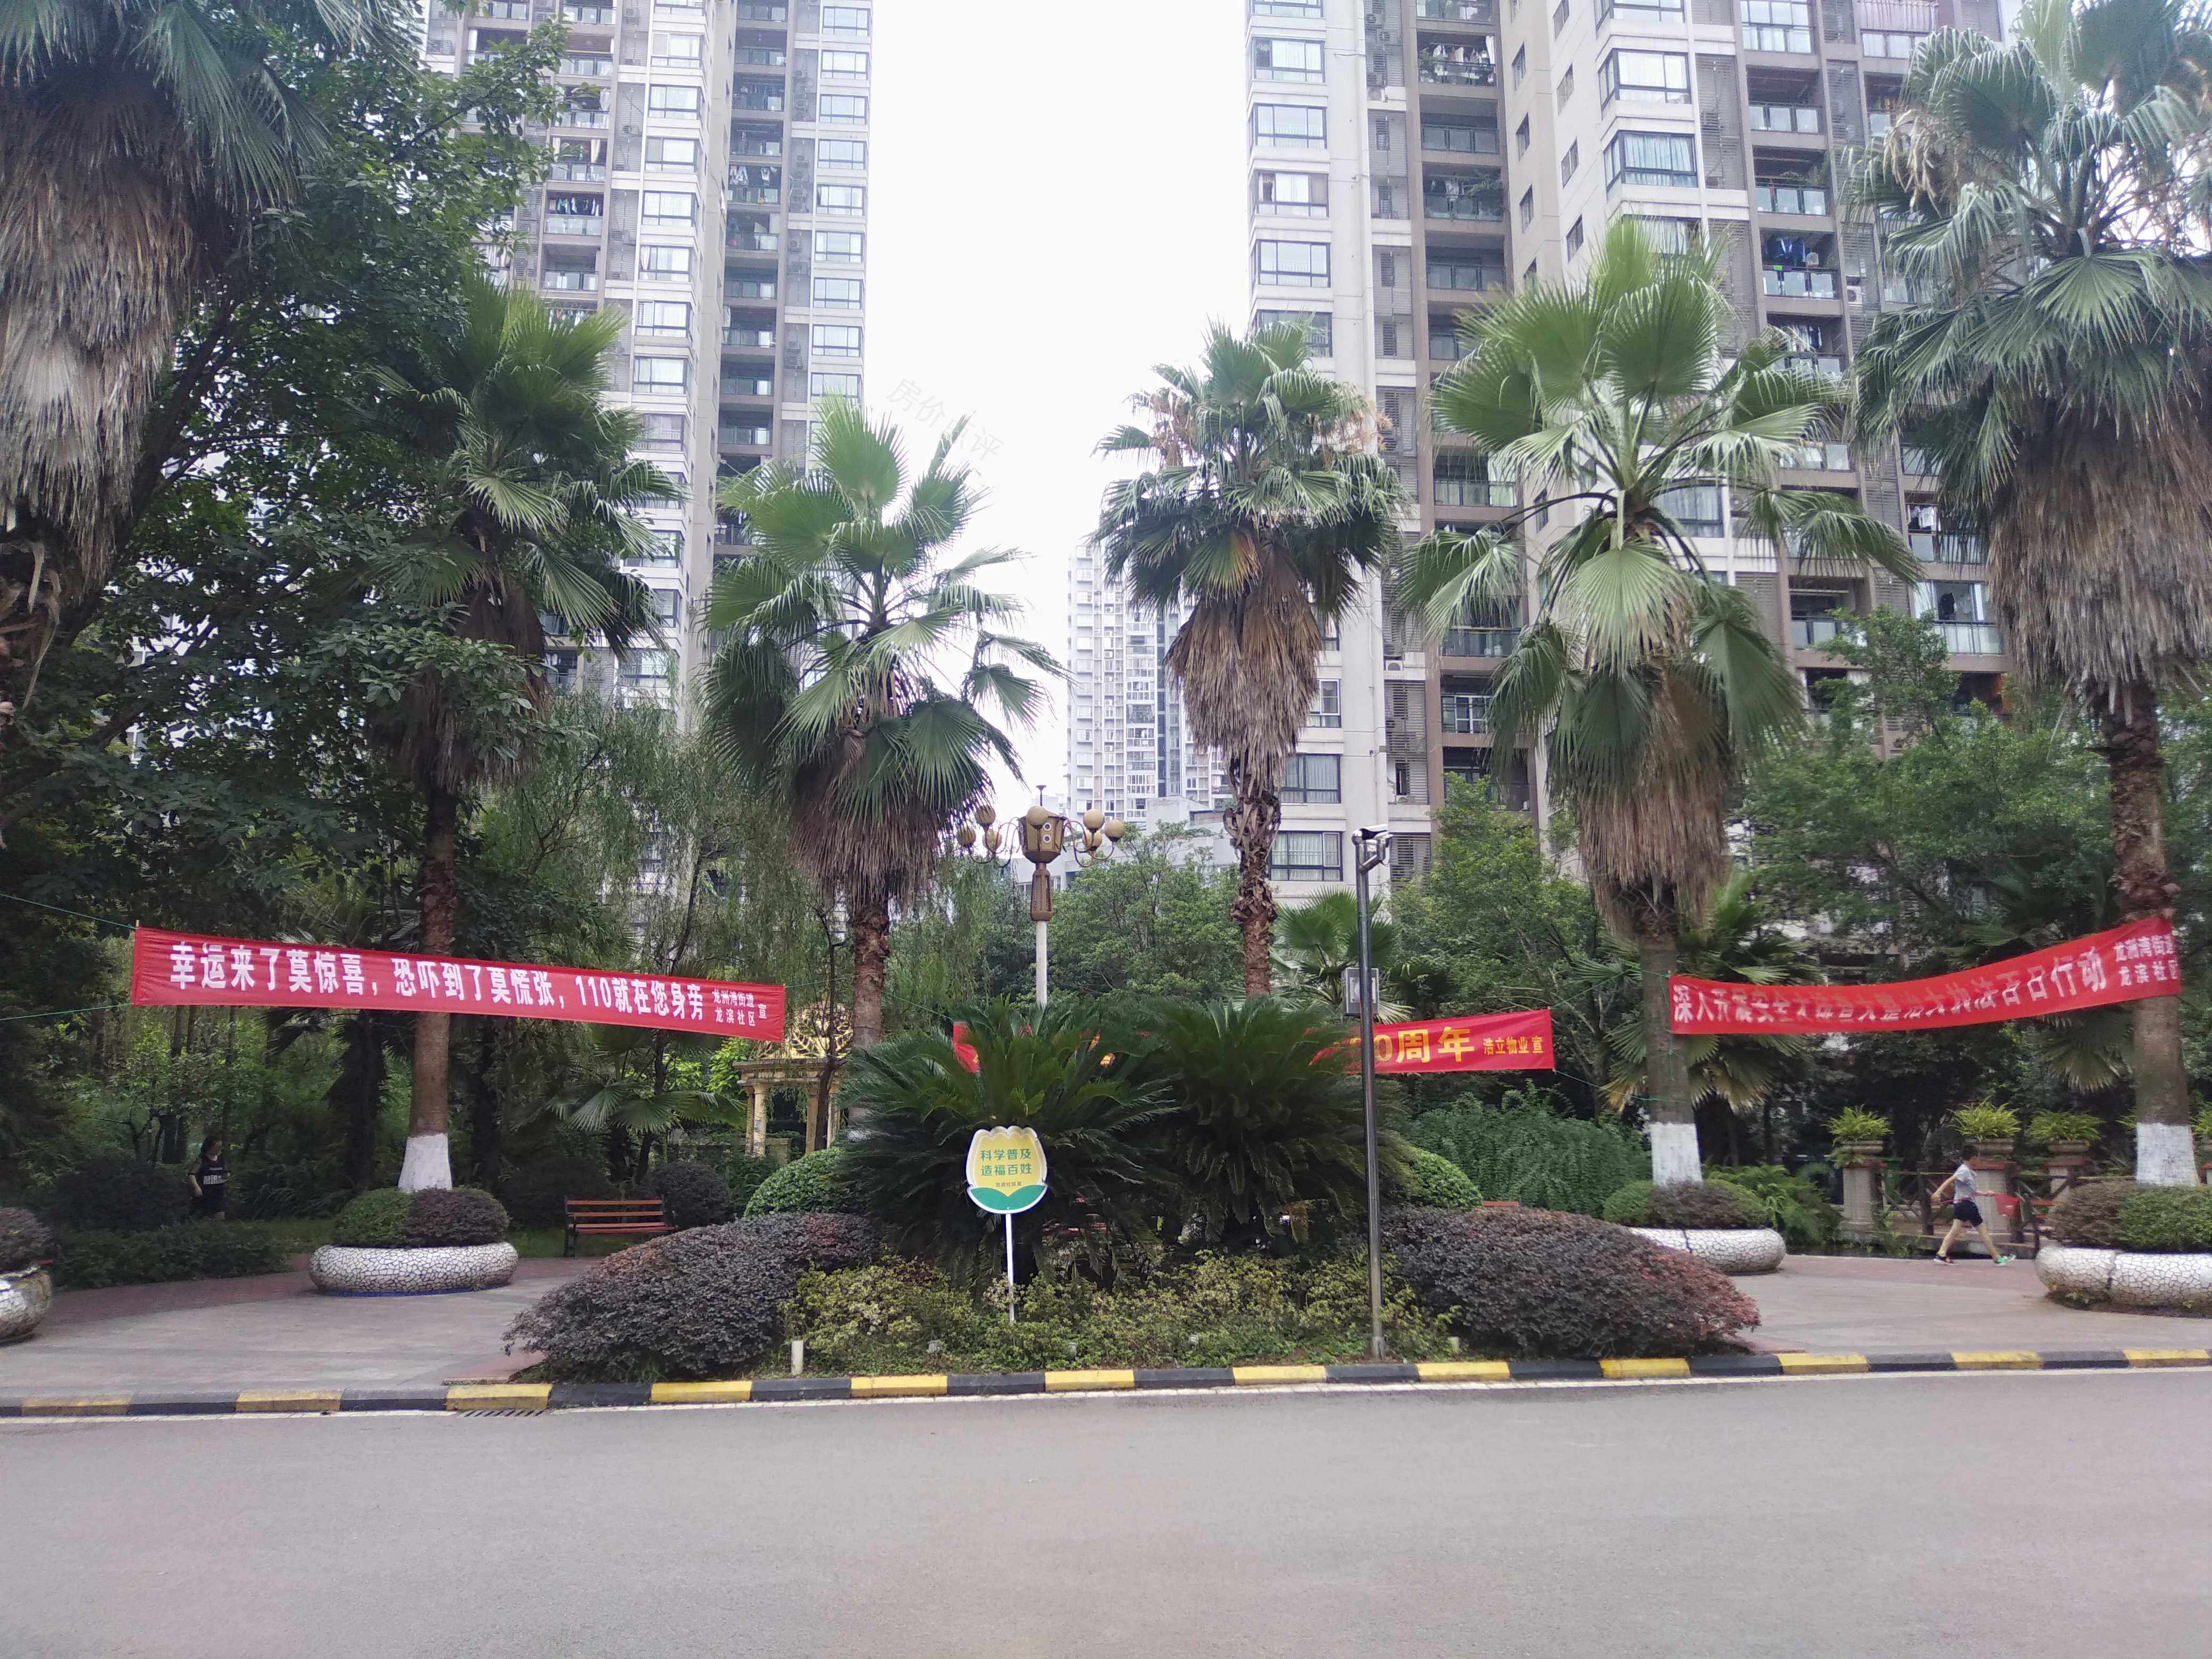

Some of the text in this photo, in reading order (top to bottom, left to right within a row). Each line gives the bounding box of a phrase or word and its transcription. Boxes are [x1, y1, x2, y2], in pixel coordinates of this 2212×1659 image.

[711, 988, 755, 1008] 龙洲湾街道
[715, 1006, 756, 1027] 龙滨社区
[980, 1148, 1032, 1161] 科学普及
[981, 1163, 1032, 1177] 造福百姓
